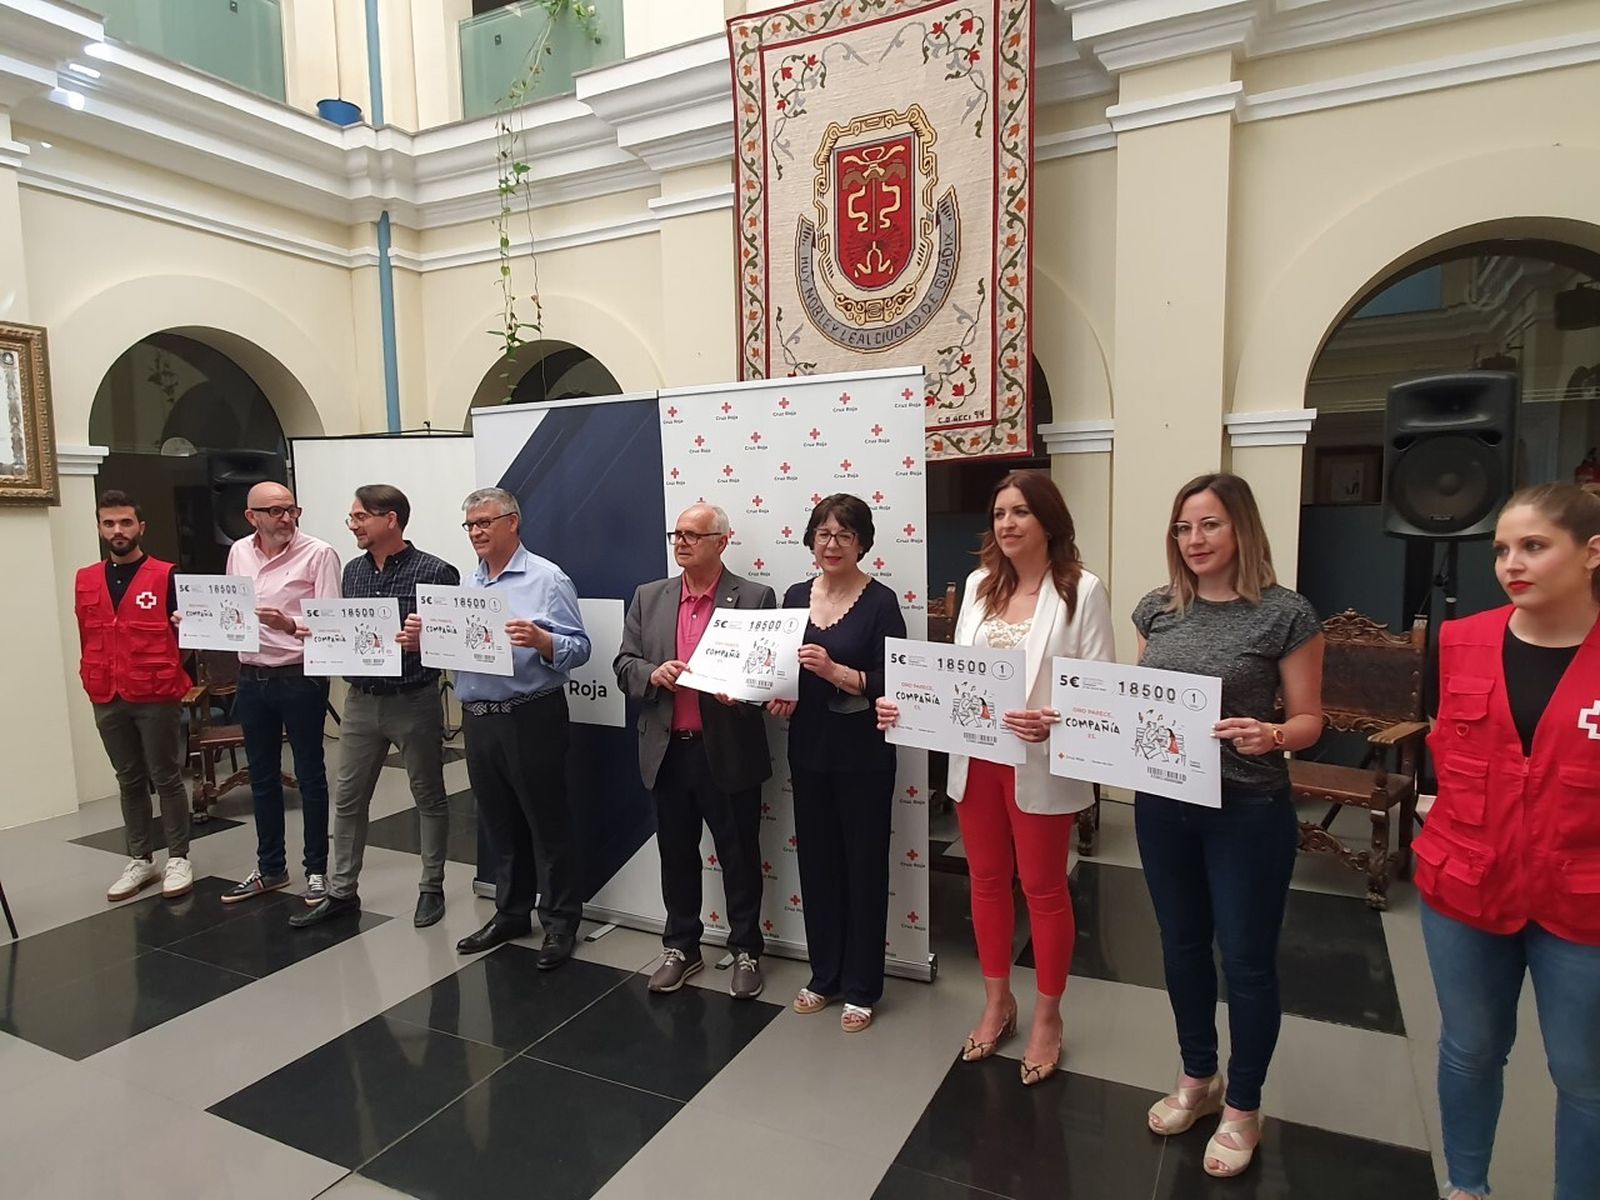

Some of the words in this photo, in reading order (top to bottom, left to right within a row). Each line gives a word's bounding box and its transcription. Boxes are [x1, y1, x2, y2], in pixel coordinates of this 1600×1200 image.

[840, 330, 872, 345] LEAL
[453, 597, 486, 609] 18500
[341, 608, 375, 618] 18500
[748, 620, 782, 631] 18500
[890, 653, 907, 665] 5€
[937, 657, 987, 674] 18500
[569, 680, 607, 700] Roja
[1059, 674, 1080, 688] 5€
[1118, 680, 1176, 701] 18500
